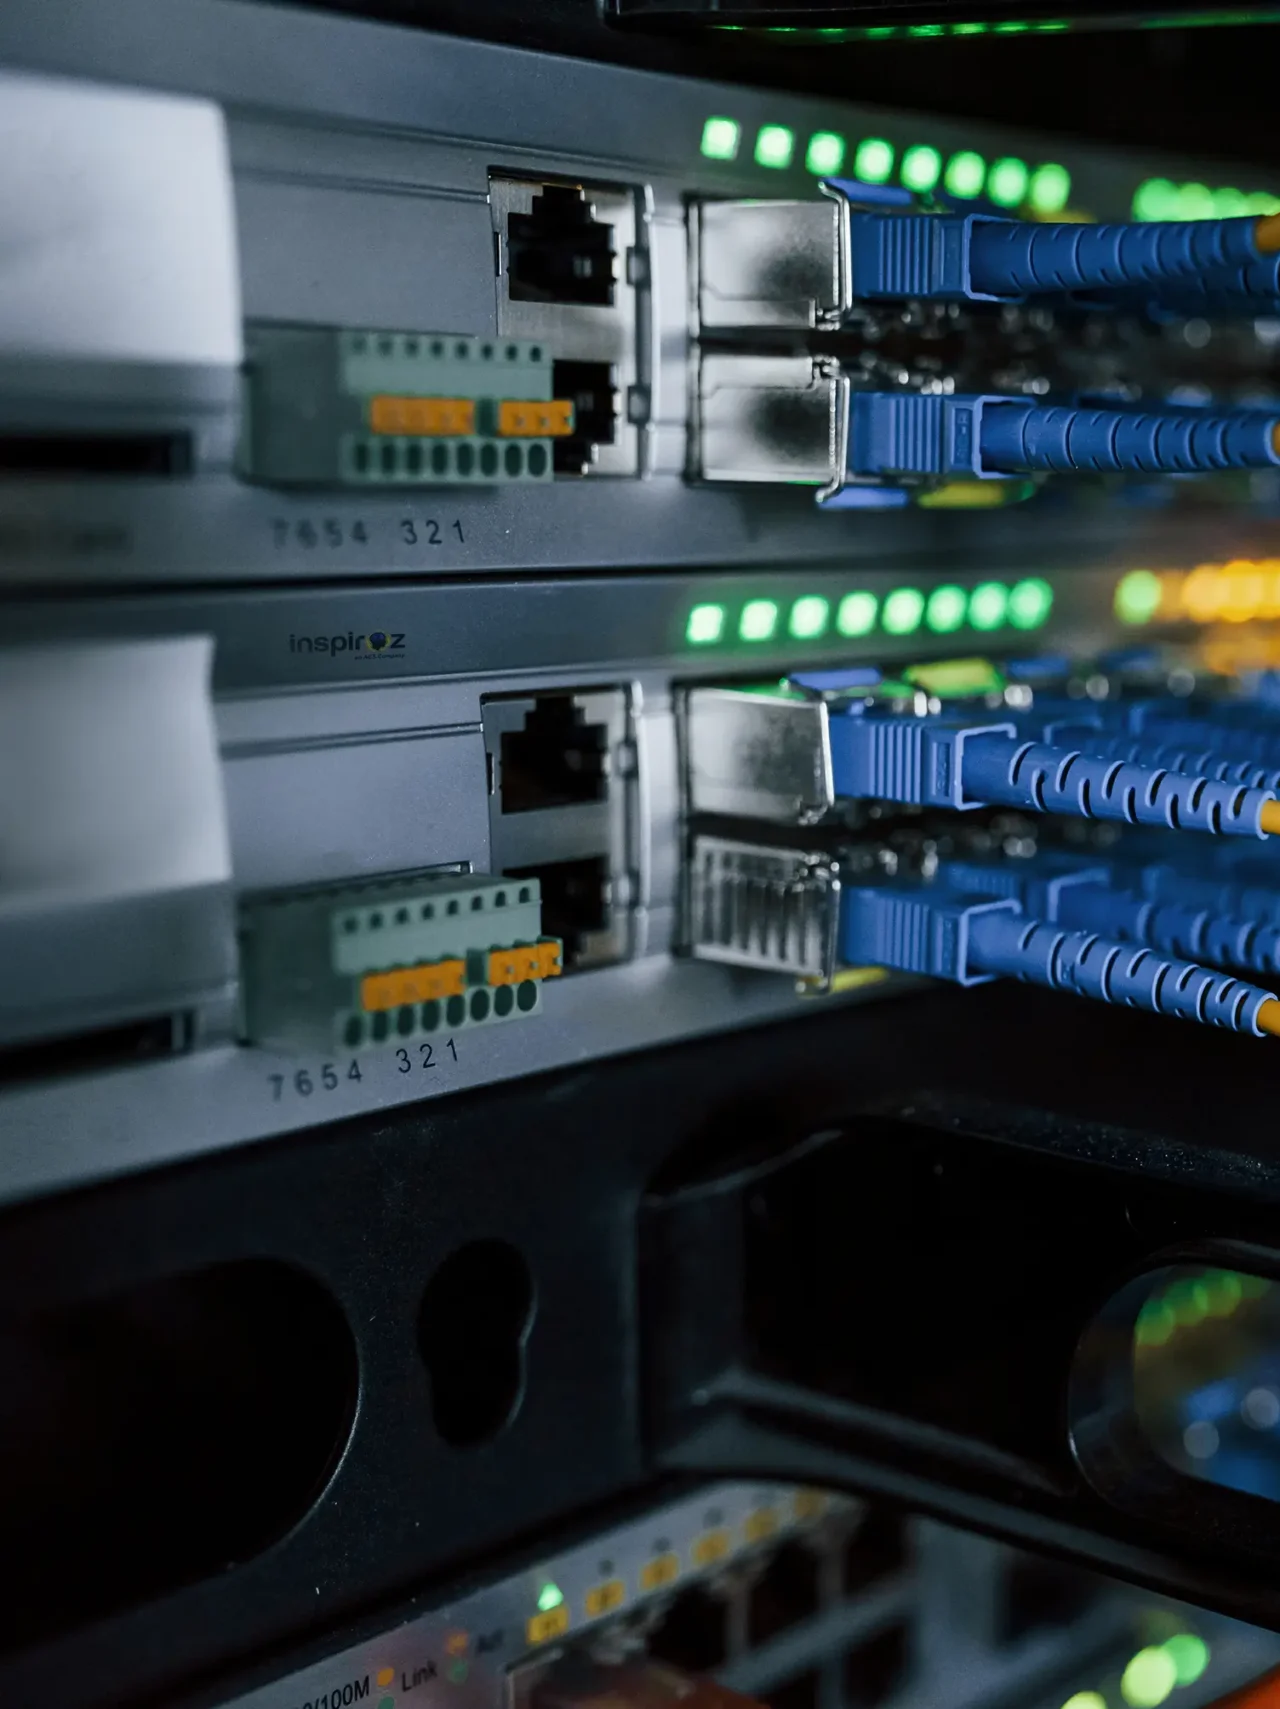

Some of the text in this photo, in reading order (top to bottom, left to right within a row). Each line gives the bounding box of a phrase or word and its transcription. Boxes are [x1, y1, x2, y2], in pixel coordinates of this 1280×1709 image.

[401, 519, 465, 545] 321
[267, 1038, 459, 1101] 7654 321
[401, 1660, 438, 1692] Link
